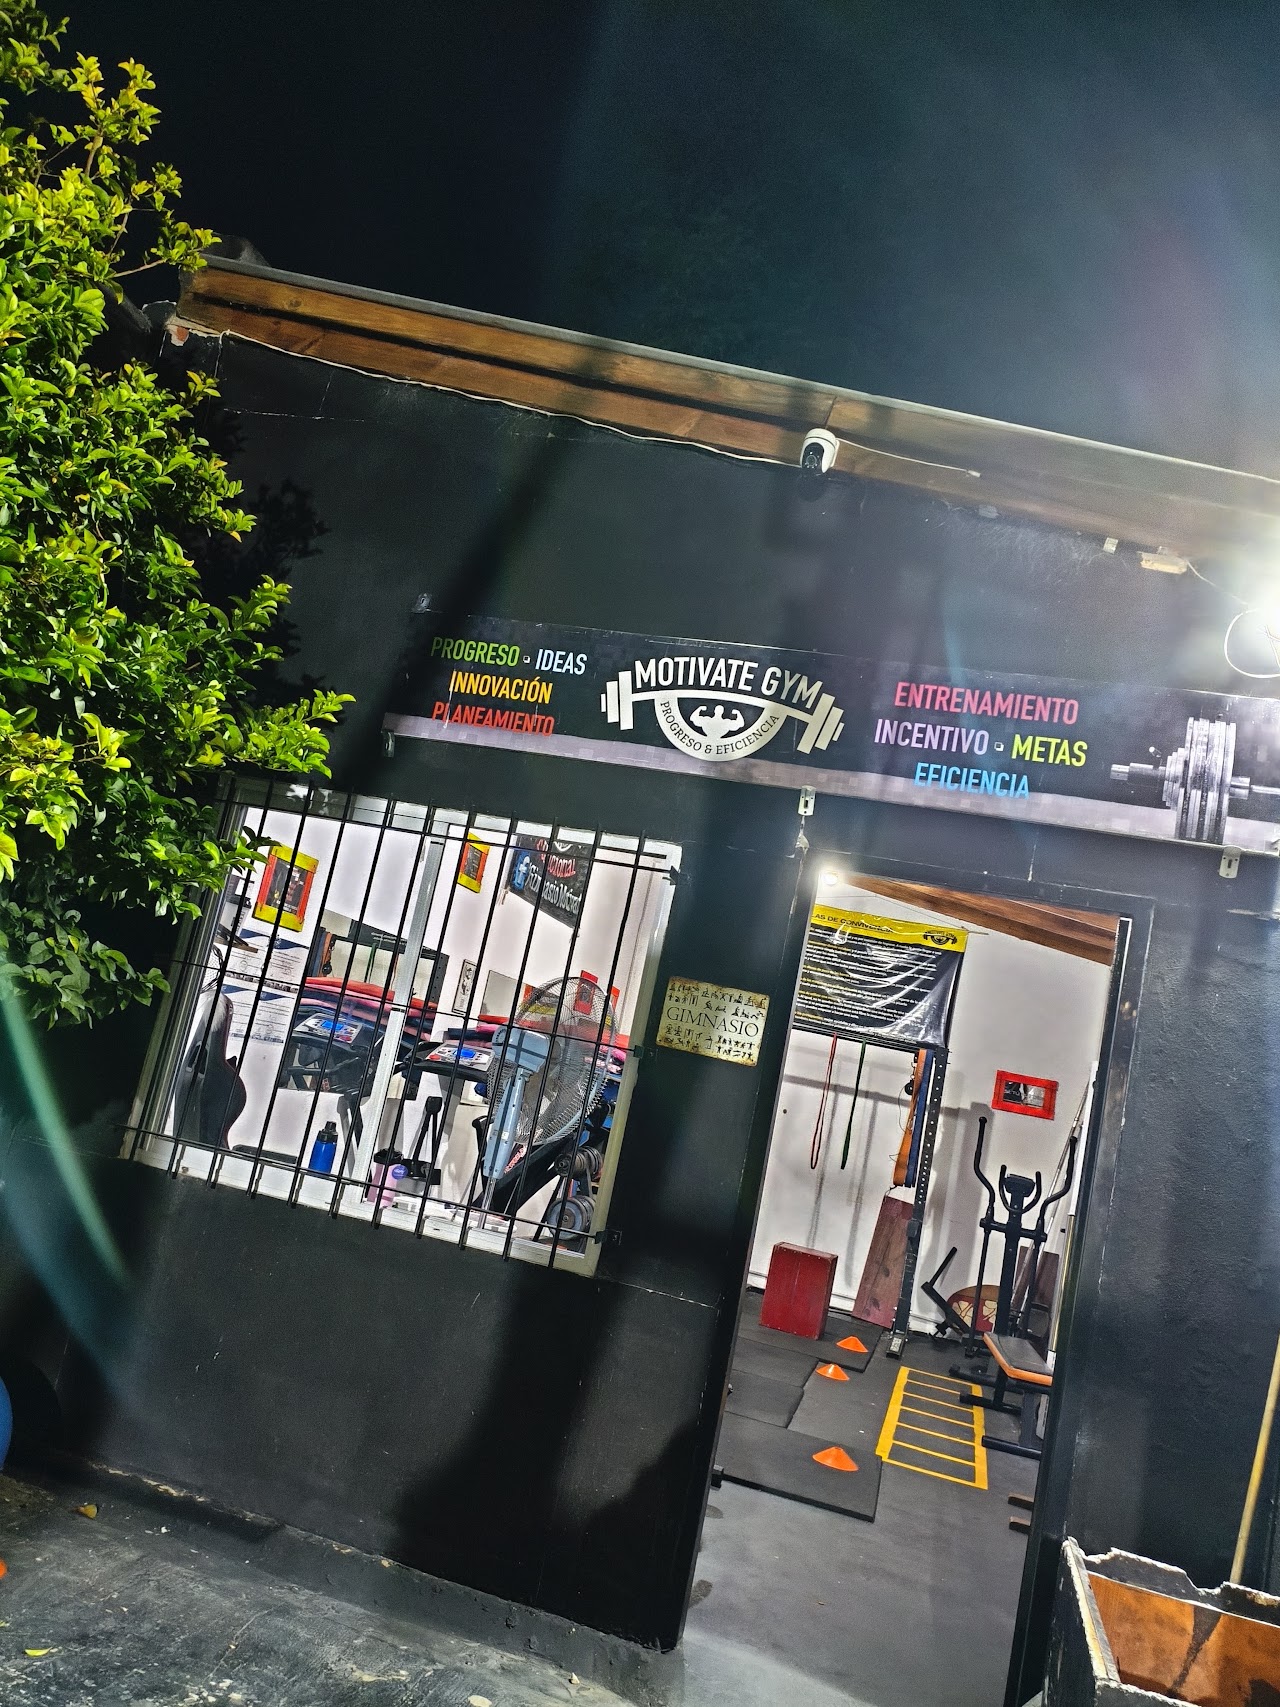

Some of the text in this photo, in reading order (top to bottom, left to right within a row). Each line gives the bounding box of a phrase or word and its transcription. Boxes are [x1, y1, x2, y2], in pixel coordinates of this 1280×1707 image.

[430, 636, 588, 675] PROGRESO IDEAS
[449, 670, 553, 704] INNOVACIÓN
[634, 656, 823, 709] MOTIVATE GYM
[431, 701, 555, 736] PLANEAMIENTO
[894, 681, 1079, 725] ENTRENAMIENTO
[660, 700, 780, 755] PROGRESO & EFICIENCIA
[874, 718, 1088, 768] INCENTIVO METAS
[913, 761, 1030, 799] EFICIENCIA
[666, 1006, 759, 1037] GIMNASIO
